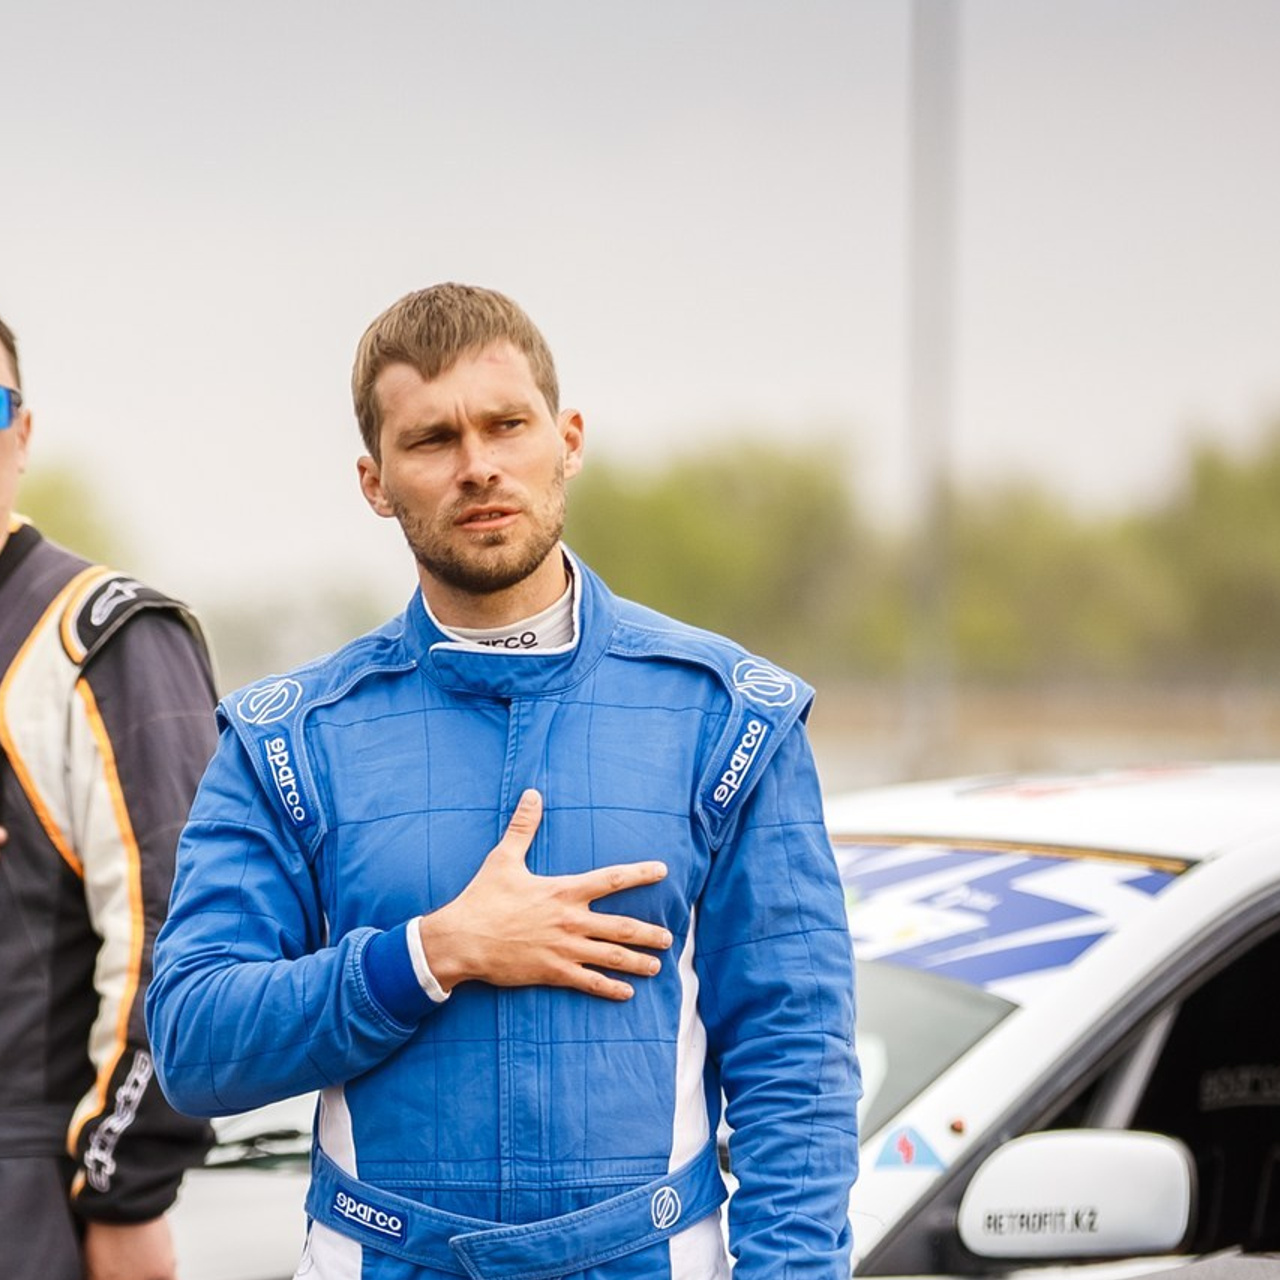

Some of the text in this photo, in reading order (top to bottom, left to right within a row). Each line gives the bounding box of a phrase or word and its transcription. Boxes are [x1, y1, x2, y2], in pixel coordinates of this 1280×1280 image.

[266, 737, 305, 822] sparco
[714, 720, 763, 804] sparco
[334, 1192, 402, 1233] sparco
